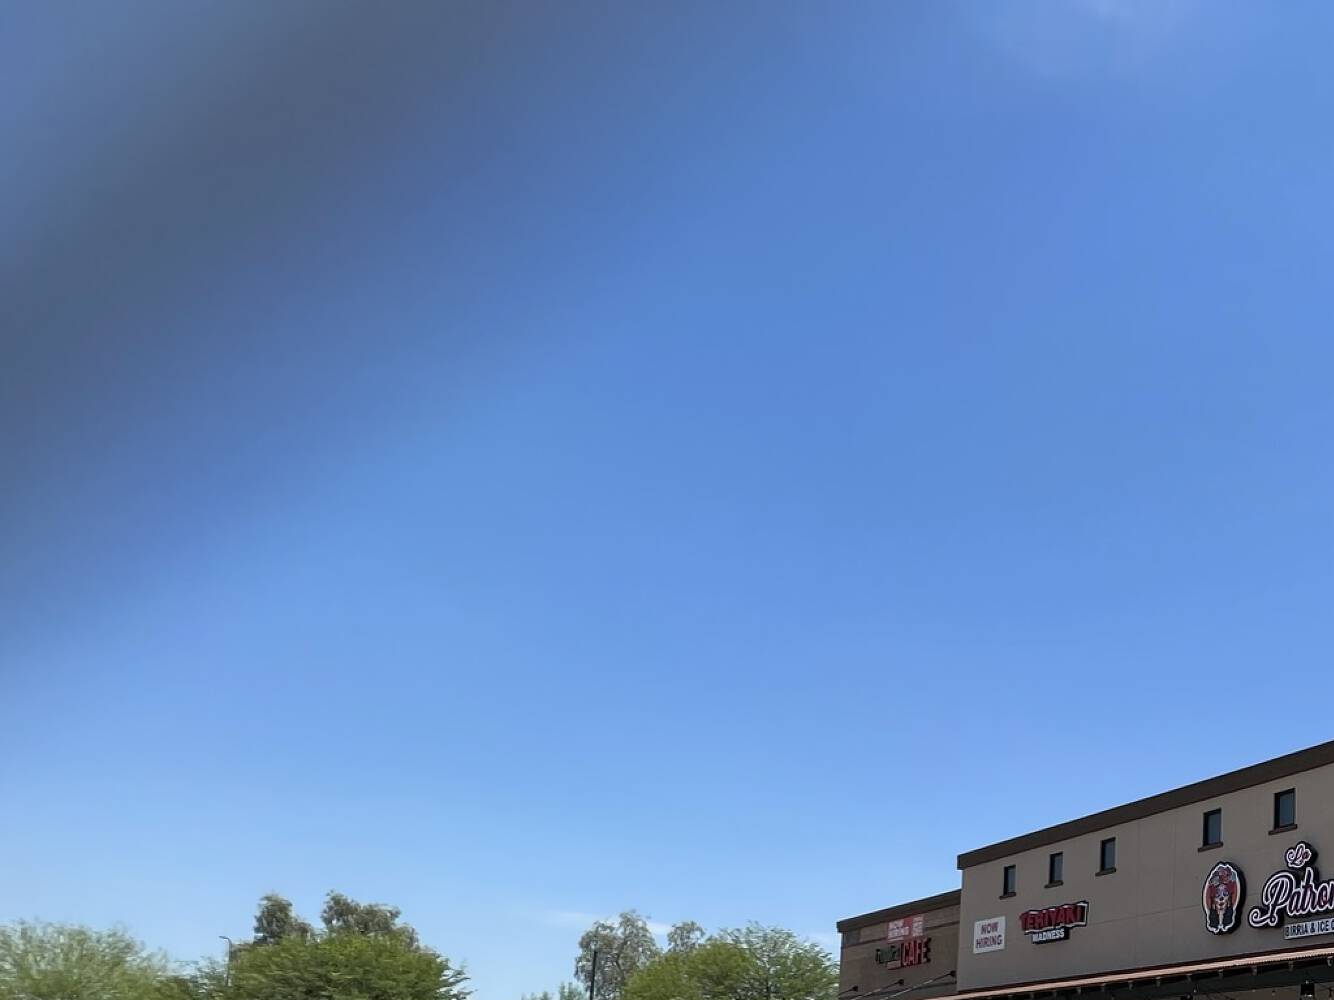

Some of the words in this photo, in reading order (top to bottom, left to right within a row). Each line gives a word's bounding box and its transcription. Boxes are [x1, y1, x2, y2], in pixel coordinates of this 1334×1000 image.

[1286, 843, 1312, 867] La
[1019, 902, 1086, 931] TERIYAKI
[981, 921, 999, 935] NOW
[1032, 929, 1066, 943] MADNESS
[1284, 923, 1309, 937] BIRRIA
[1310, 921, 1316, 934] &
[1317, 920, 1329, 933] ICE
[976, 934, 1002, 949] HIRING
